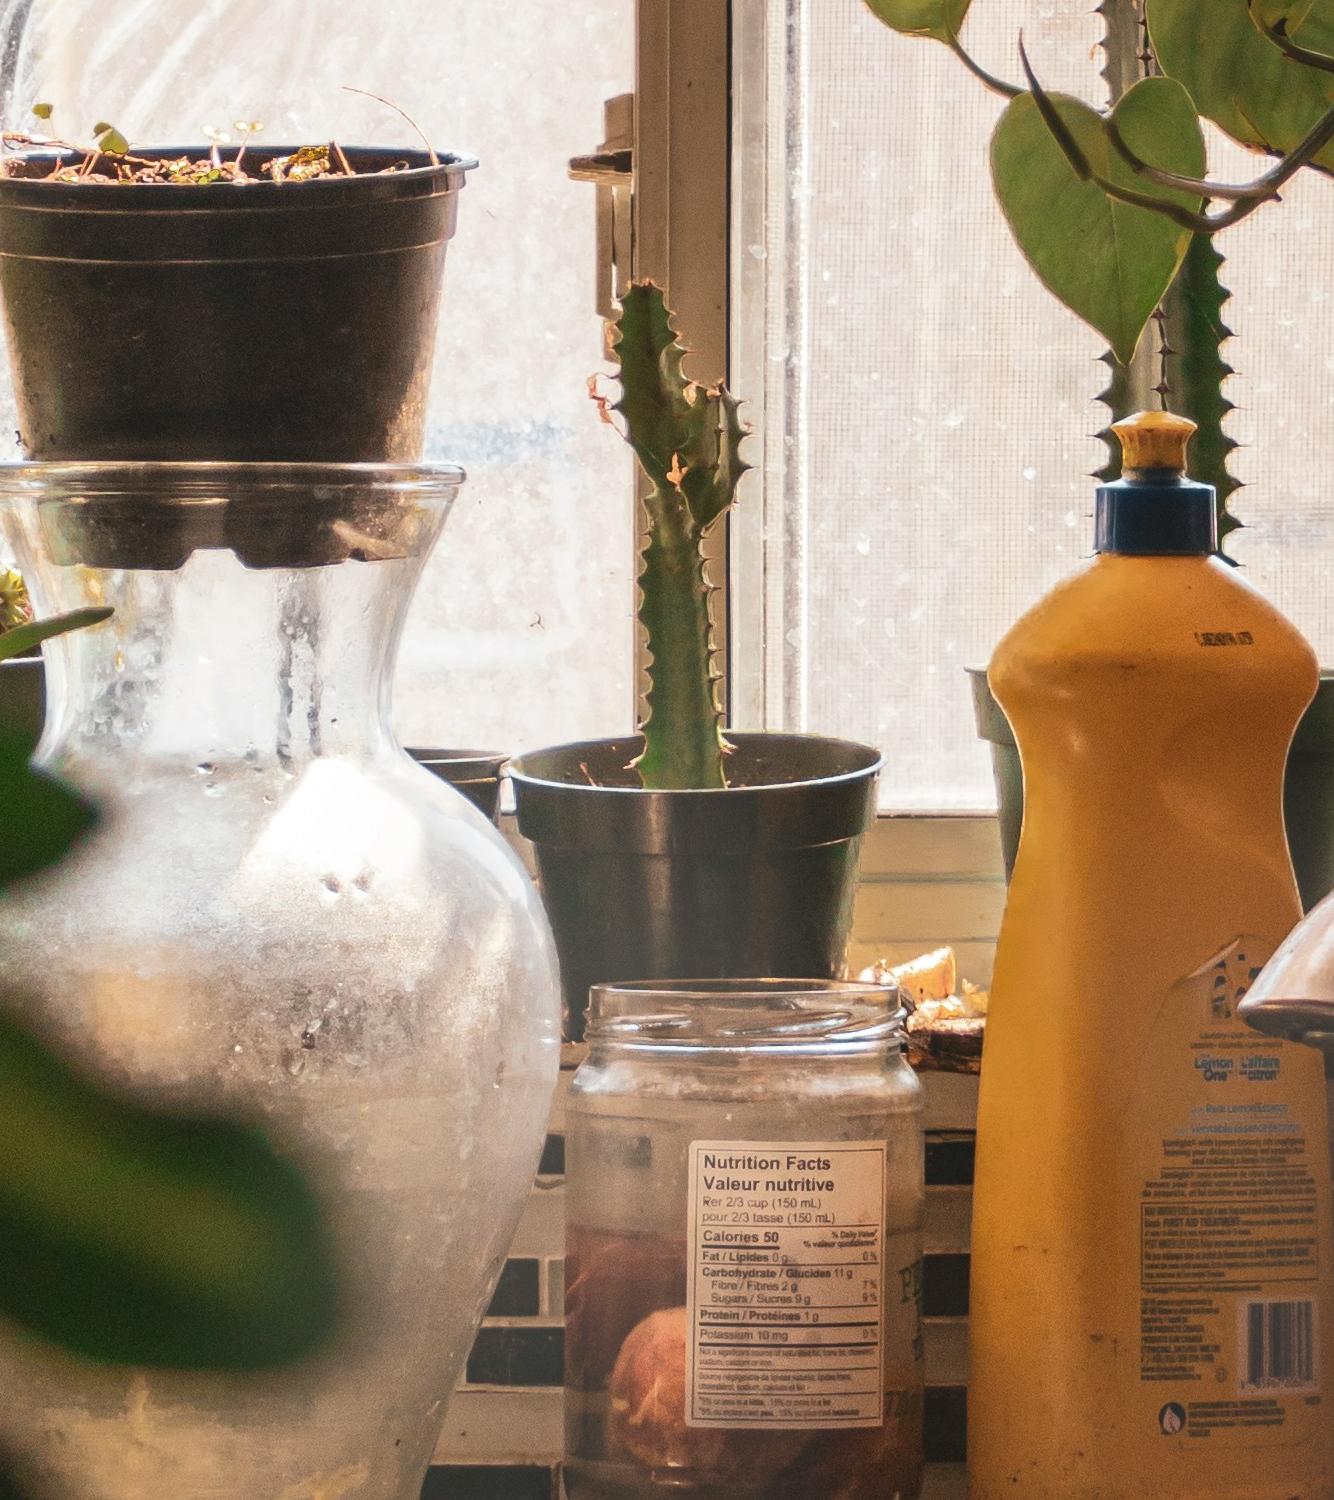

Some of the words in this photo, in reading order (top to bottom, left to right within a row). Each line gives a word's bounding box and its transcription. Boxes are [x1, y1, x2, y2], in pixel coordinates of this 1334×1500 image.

[1194, 1057, 1234, 1069] Lemon
[704, 1154, 781, 1171] Nutrition
[786, 1156, 831, 1171] Facts
[703, 1176, 760, 1192] Valeur
[765, 1177, 835, 1192] nutritive
[726, 1196, 744, 1208] 2/3
[747, 1198, 769, 1210] cup
[771, 1197, 797, 1211] (150
[800, 1197, 822, 1210] mL)
[702, 1213, 728, 1224] pour
[731, 1212, 750, 1224] 2/3
[753, 1212, 784, 1224] tasse
[787, 1211, 812, 1224] (150
[815, 1212, 836, 1224] mL)
[703, 1230, 759, 1243] Calories
[763, 1231, 779, 1243] 50
[702, 1251, 720, 1262] Fat
[722, 1252, 727, 1262] /
[729, 1252, 769, 1263] Lipides
[772, 1253, 779, 1262] 0
[701, 1267, 777, 1279] Carbohydrate
[778, 1268, 784, 1278] /
[785, 1268, 831, 1279] Glucides
[835, 1268, 844, 1278] 11
[846, 1270, 853, 1280] g
[711, 1280, 738, 1291] Fibre
[739, 1280, 744, 1291] /
[746, 1280, 779, 1291] Fibres
[781, 1280, 788, 1291] 2
[790, 1282, 799, 1293] g
[711, 1293, 748, 1306] Sugars
[749, 1293, 754, 1303] /
[756, 1293, 793, 1304] Sucres
[794, 1293, 803, 1304] 9
[804, 1295, 812, 1306] g
[700, 1309, 739, 1321] Protein
[742, 1310, 747, 1321] /
[749, 1309, 801, 1321] Protéines
[804, 1311, 810, 1321] 1
[812, 1312, 819, 1323] g
[700, 1329, 754, 1340] Potassium
[757, 1330, 770, 1340] 10
[772, 1332, 789, 1342] mg
